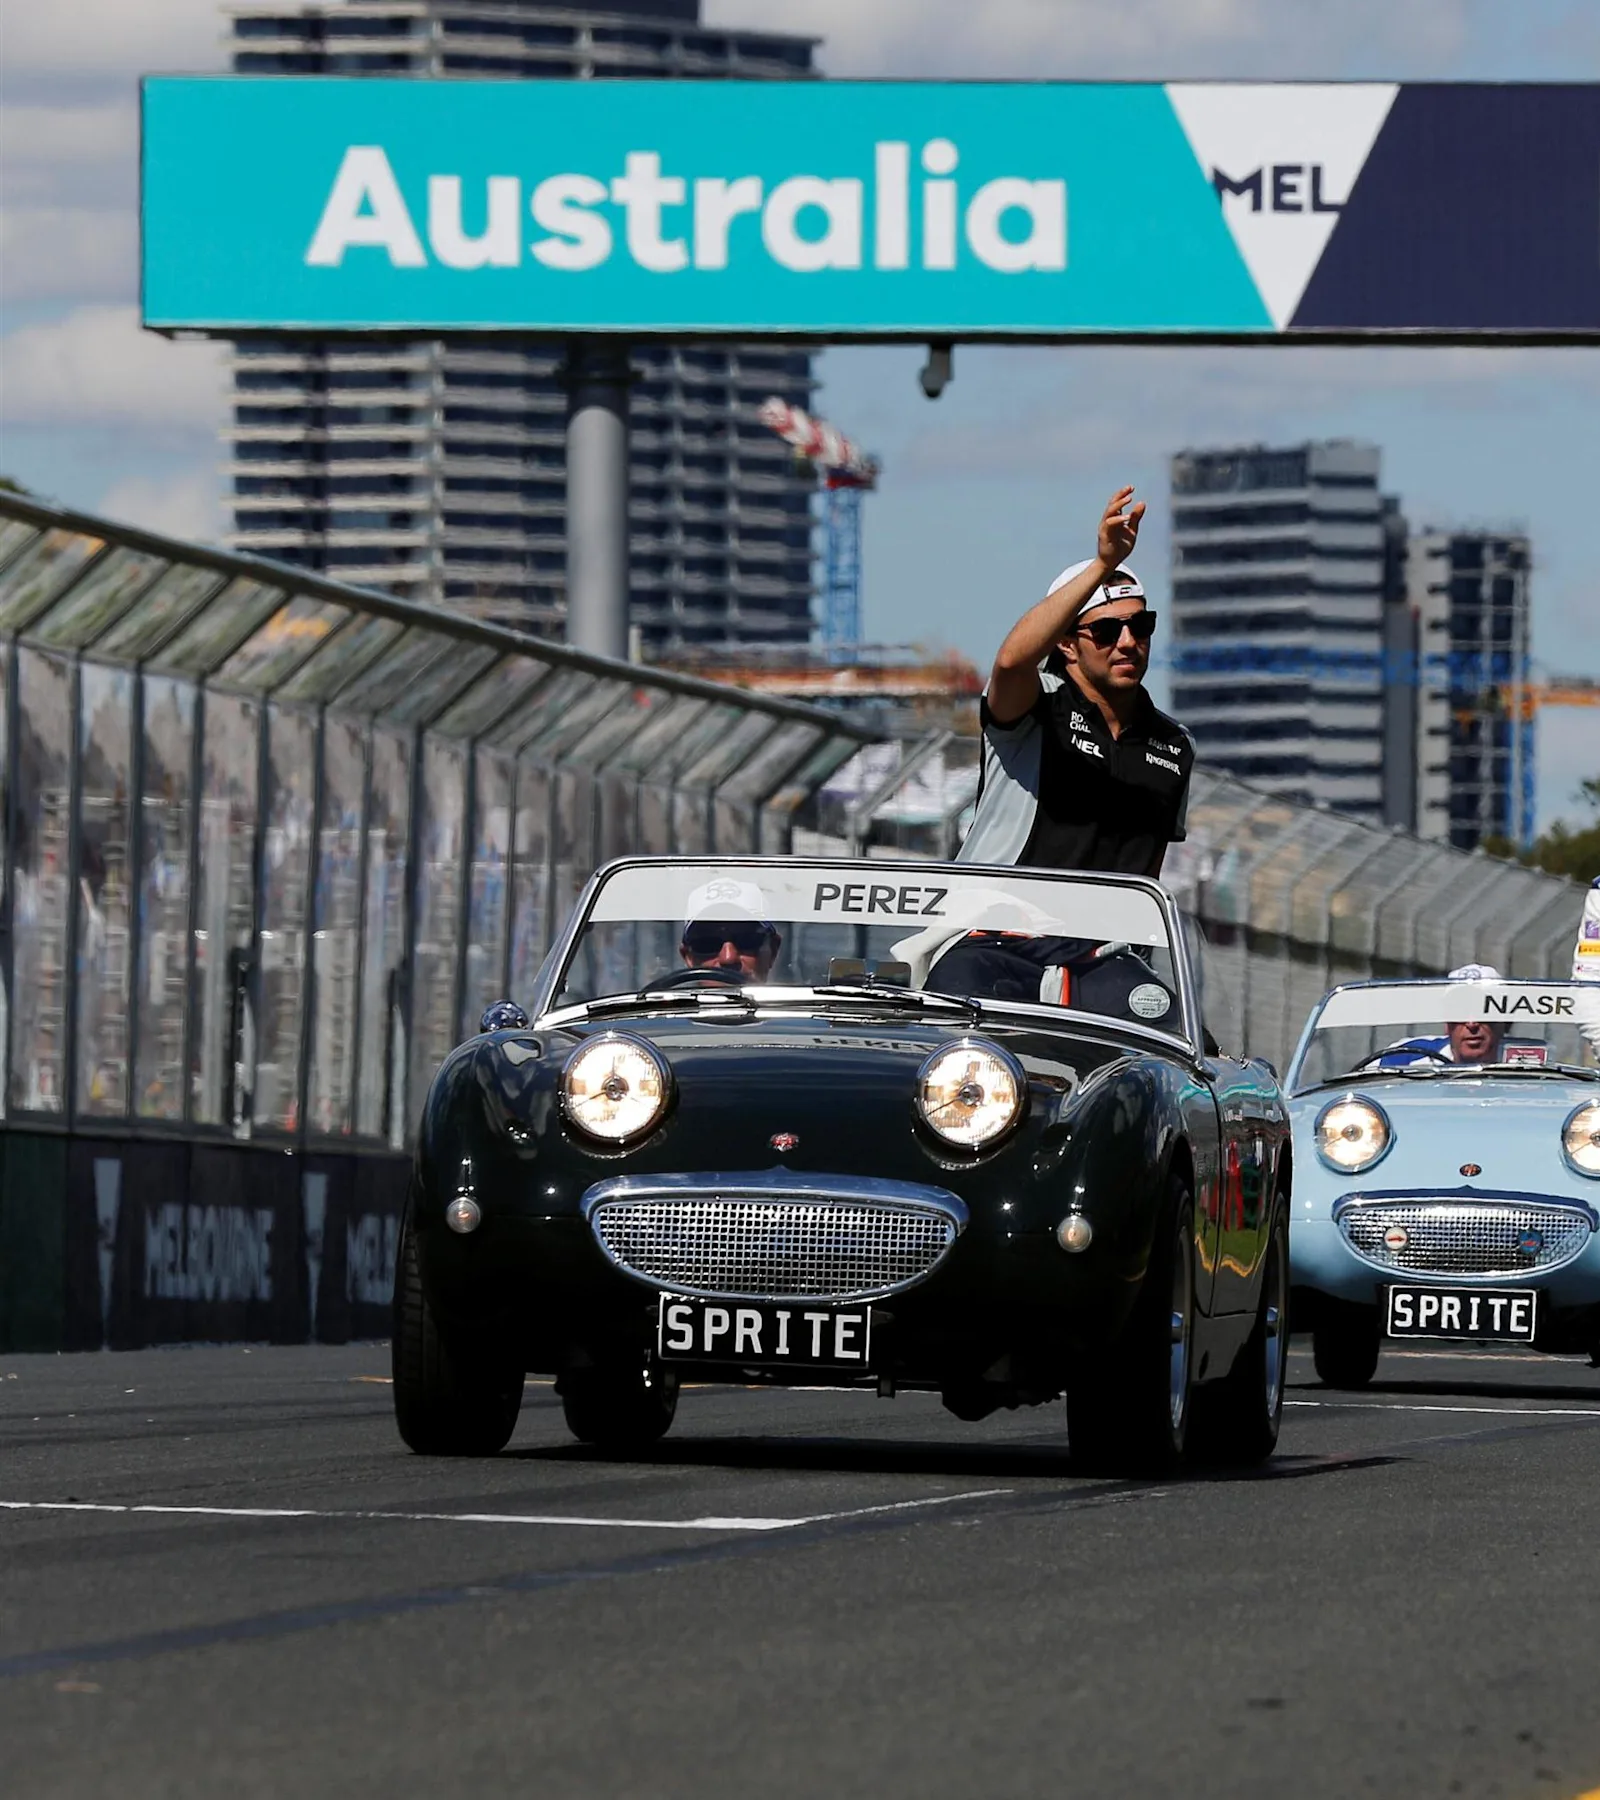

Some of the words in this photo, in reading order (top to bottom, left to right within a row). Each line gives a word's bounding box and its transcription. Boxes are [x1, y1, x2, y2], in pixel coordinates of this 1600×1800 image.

[305, 139, 1066, 271] Australia
[1212, 165, 1349, 213] MEL
[1146, 752, 1180, 775] KINGFISHER
[813, 883, 948, 916] PEREZ
[1483, 995, 1575, 1015] NASR
[144, 1203, 275, 1302] MELBOURNE
[667, 1305, 862, 1359] SPRITE
[1394, 1294, 1530, 1332] SPRITE
